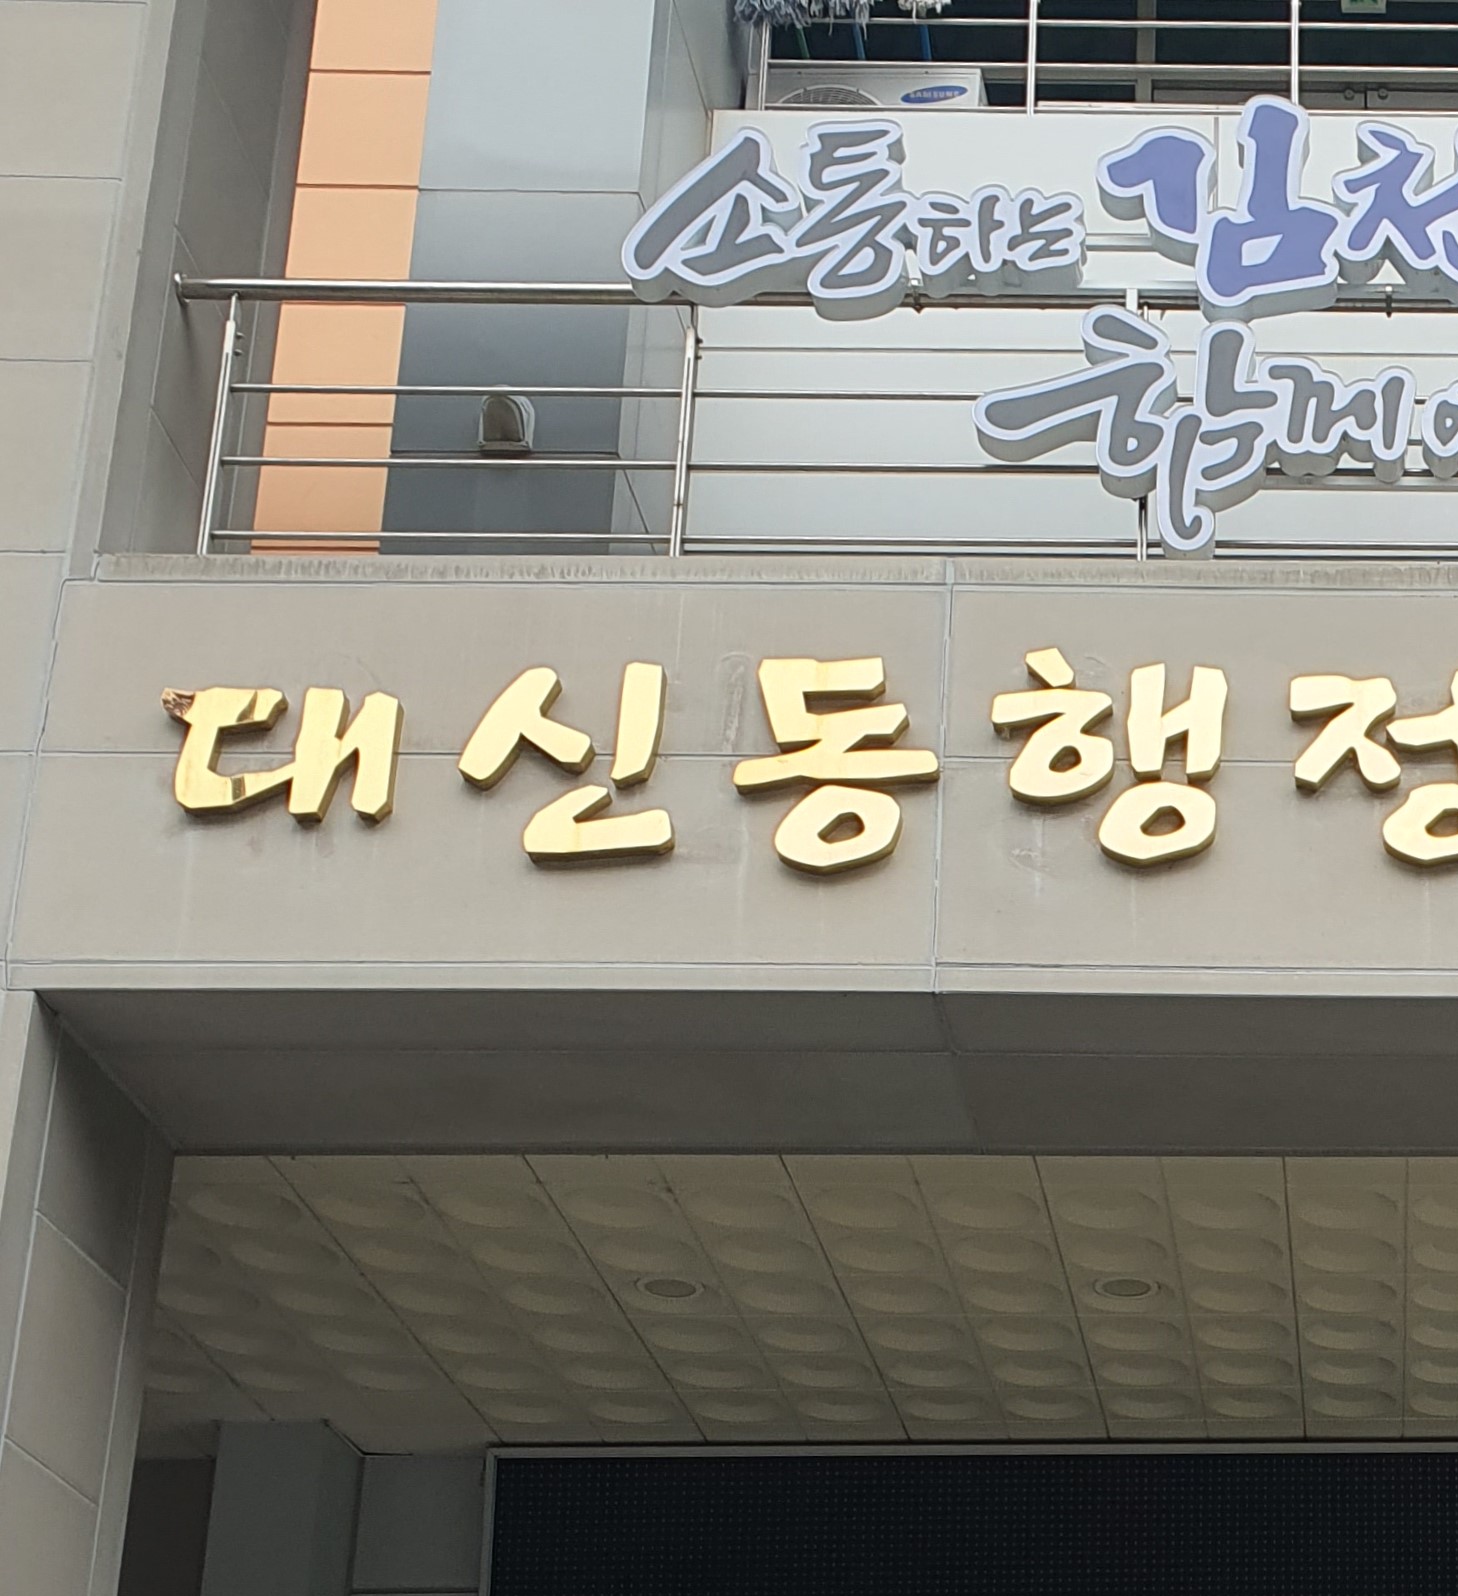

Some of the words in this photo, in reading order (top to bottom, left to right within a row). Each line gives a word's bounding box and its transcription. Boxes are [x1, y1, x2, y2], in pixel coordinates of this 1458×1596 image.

[909, 90, 960, 99] SAMSUNG
[622, 119, 1084, 304] 소통하는
[973, 305, 1416, 553] 함께
